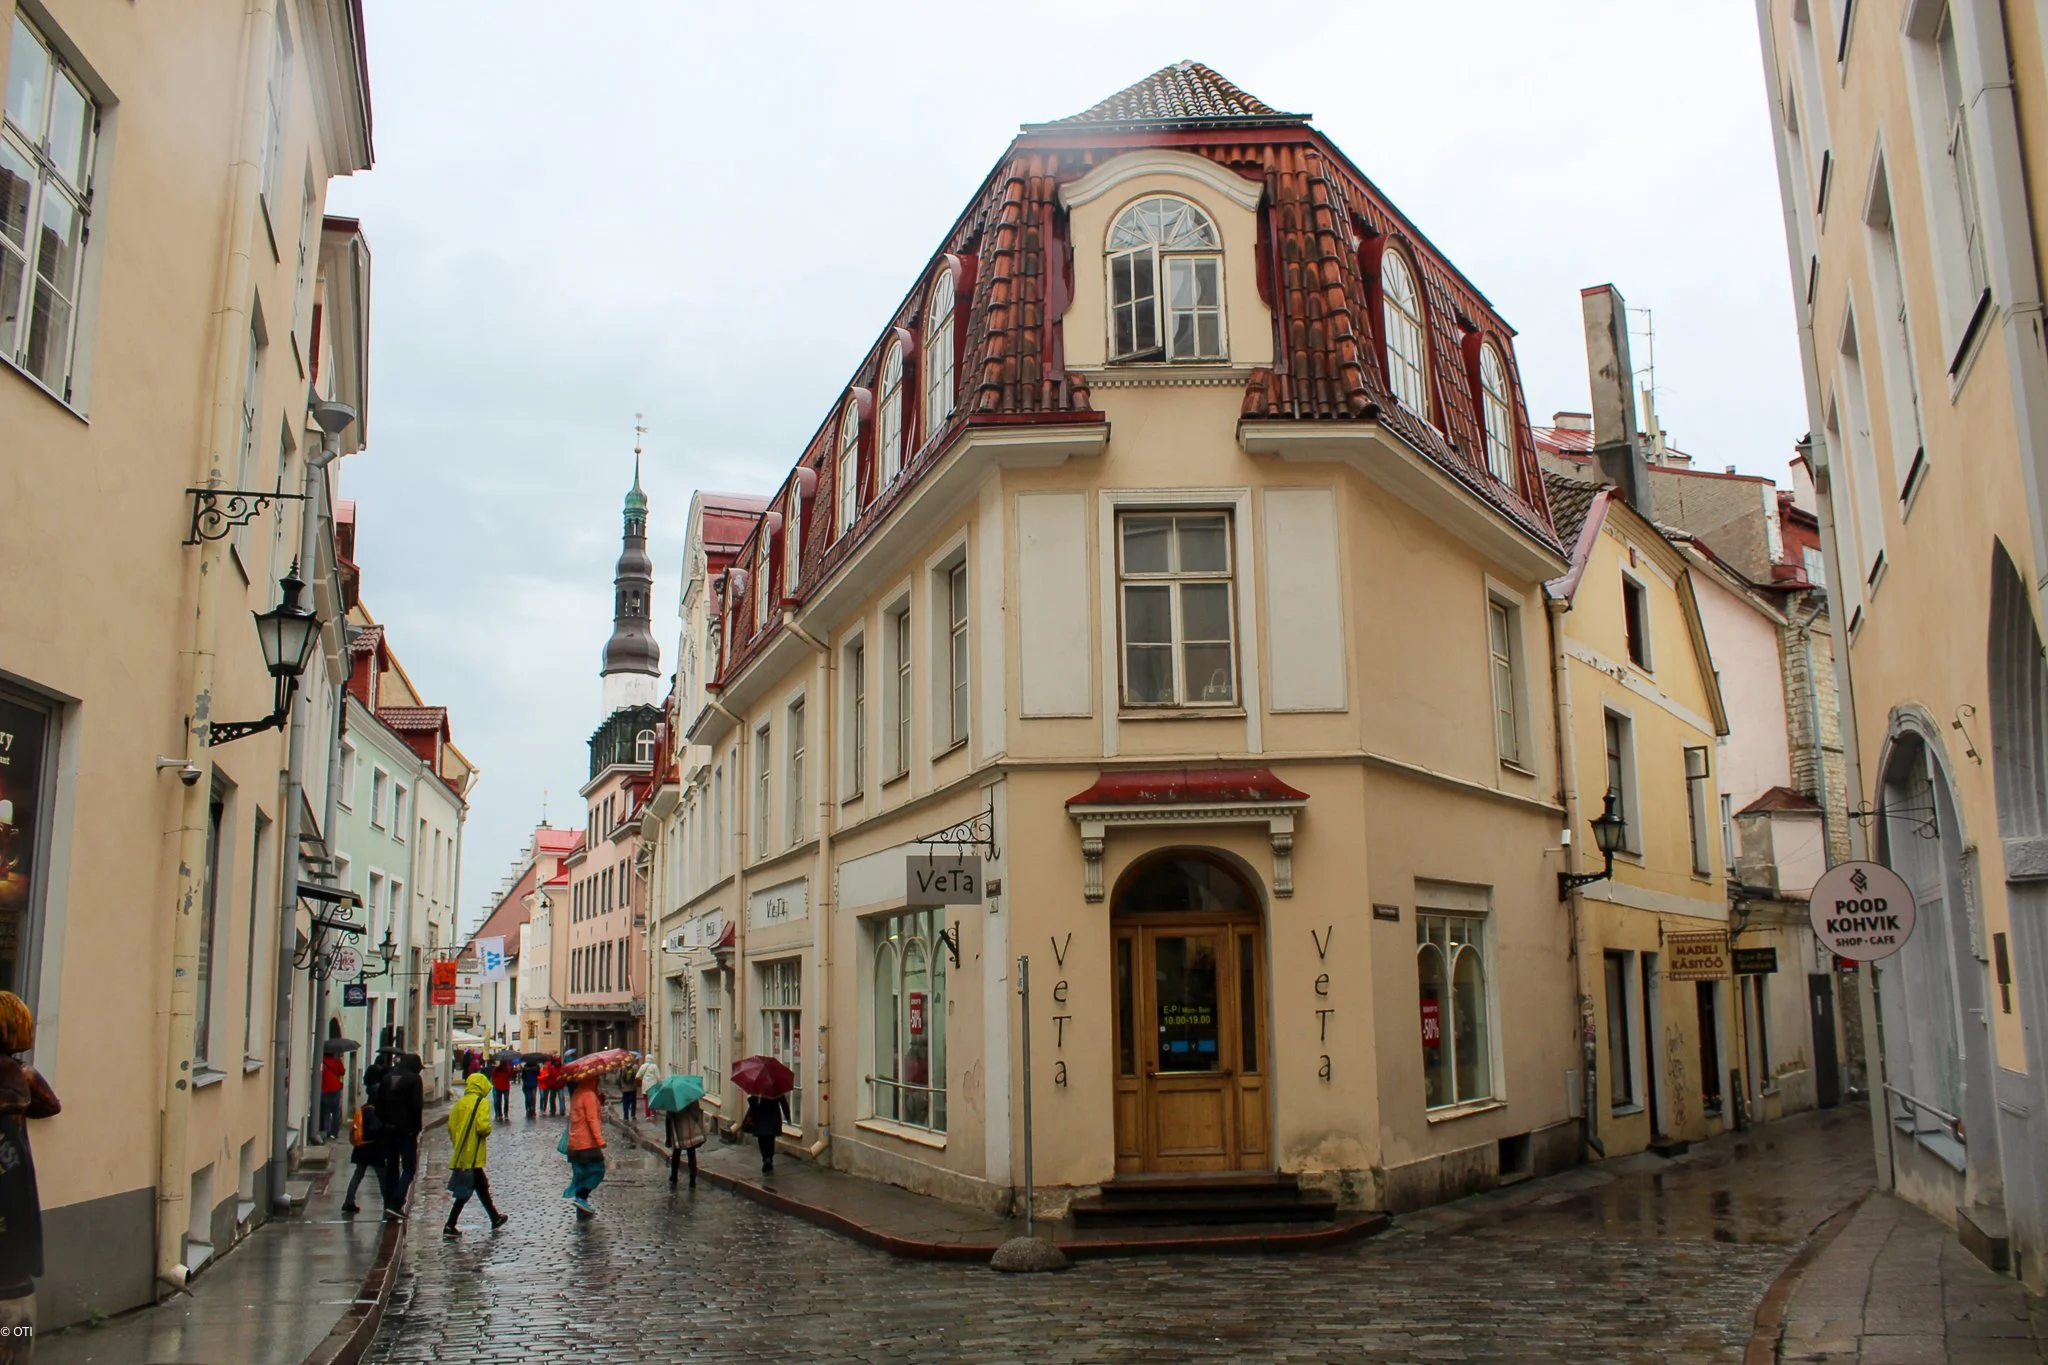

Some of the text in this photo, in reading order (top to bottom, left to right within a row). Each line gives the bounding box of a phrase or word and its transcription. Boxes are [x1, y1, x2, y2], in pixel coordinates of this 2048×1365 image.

[916, 869, 974, 894] VeTa
[1835, 898, 1888, 915] POOD
[1826, 915, 1900, 934] KOHVIK
[1676, 945, 1718, 955] MADELI
[1835, 935, 1896, 947] SHOP CAFE
[1051, 932, 1072, 1088] VeTa
[1311, 925, 1335, 1082] VeTa
[1164, 1015, 1211, 1025] 10.00-19.00
[1423, 1018, 1440, 1040] -50%
